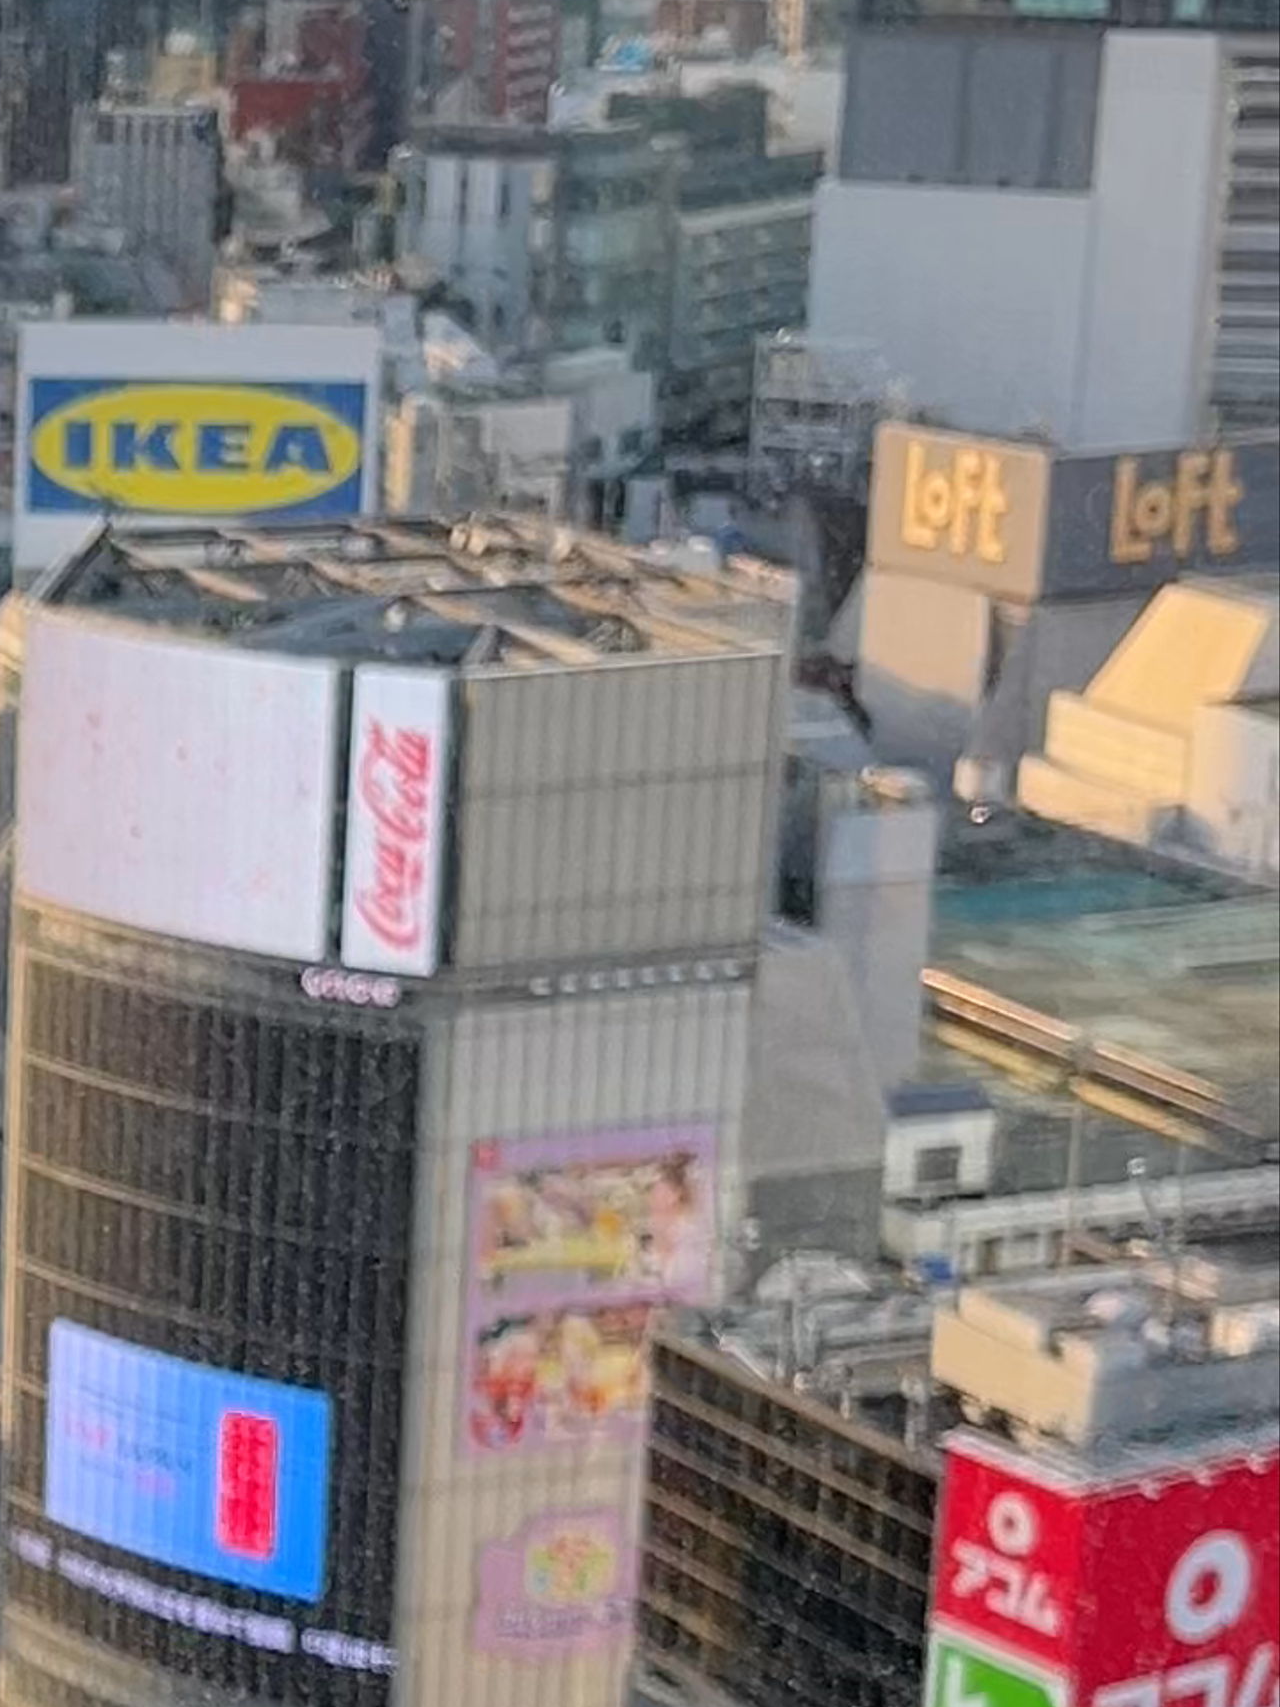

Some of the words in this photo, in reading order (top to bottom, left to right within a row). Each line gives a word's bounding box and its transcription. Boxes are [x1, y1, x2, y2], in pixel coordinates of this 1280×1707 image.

[64, 420, 332, 474] IKEA
[901, 439, 1009, 563] Loft
[1108, 450, 1244, 564] Loft
[354, 717, 429, 952] Coca-Cola
[950, 1535, 1064, 1638] アコム
